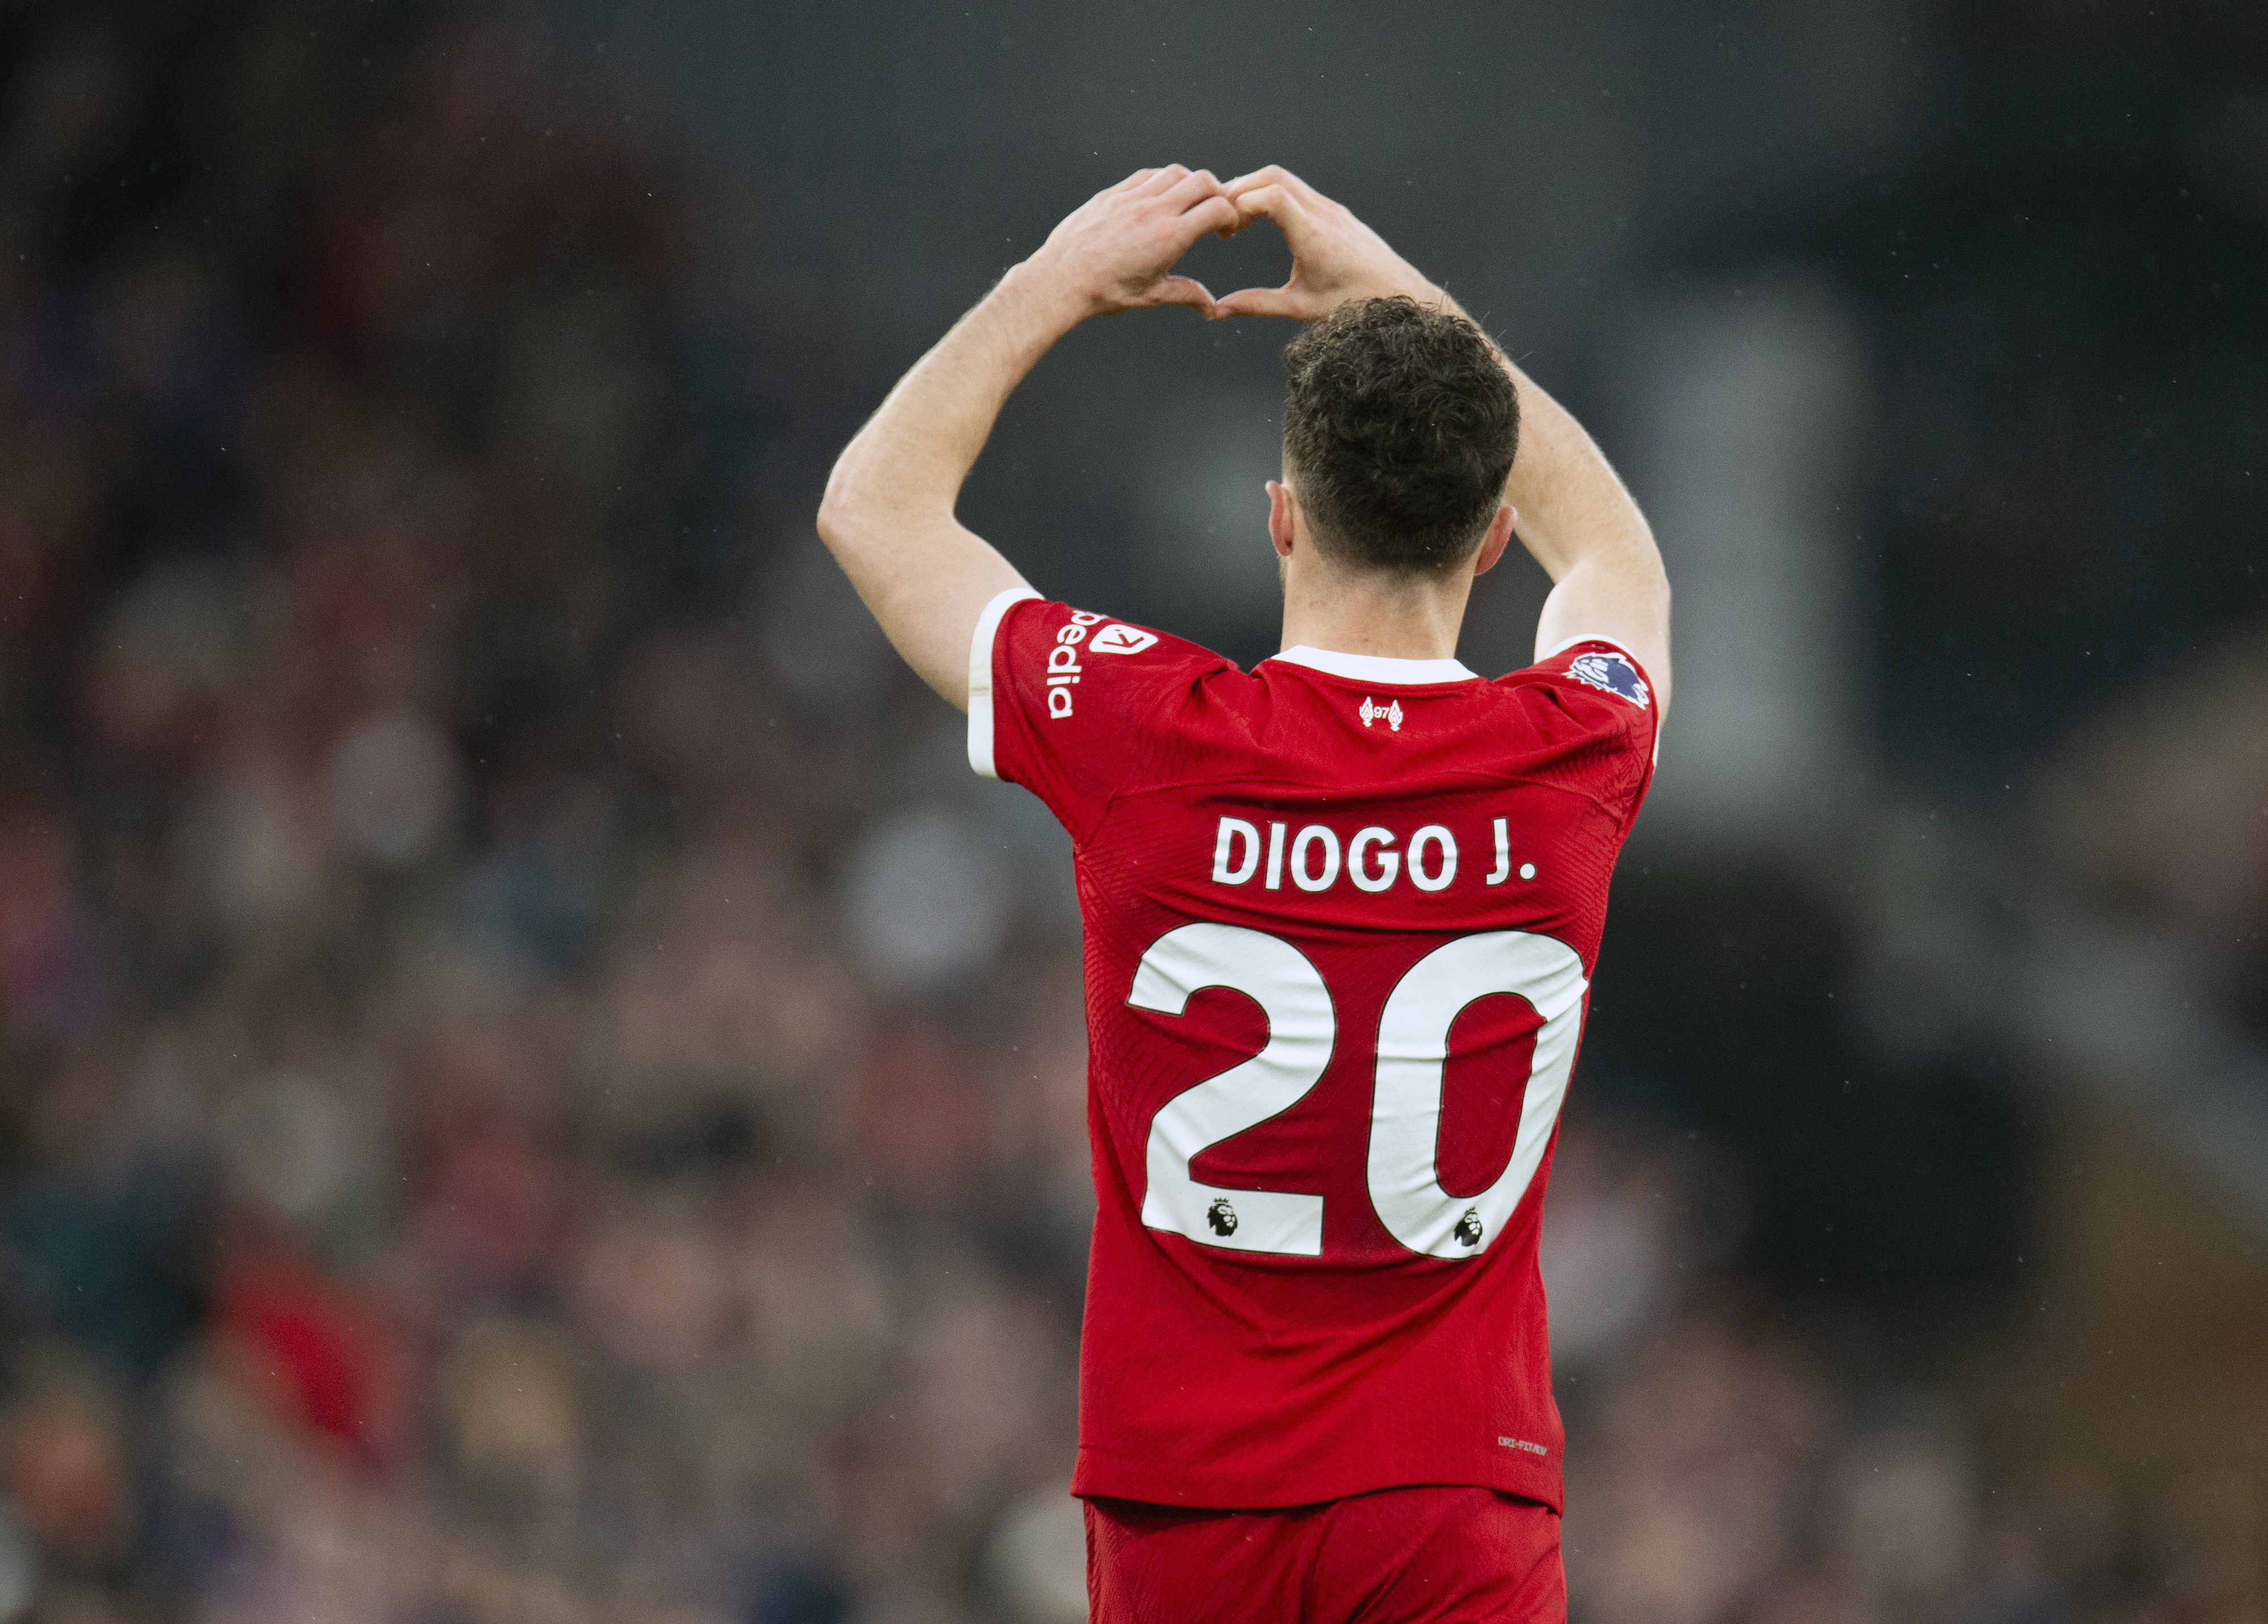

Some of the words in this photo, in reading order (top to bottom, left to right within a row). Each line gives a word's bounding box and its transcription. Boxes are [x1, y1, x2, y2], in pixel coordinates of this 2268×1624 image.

[1373, 706, 1390, 719] 97
[1212, 815, 1458, 893] DIOGO
[1486, 817, 1536, 886] J.
[1125, 922, 1589, 1261] 20
